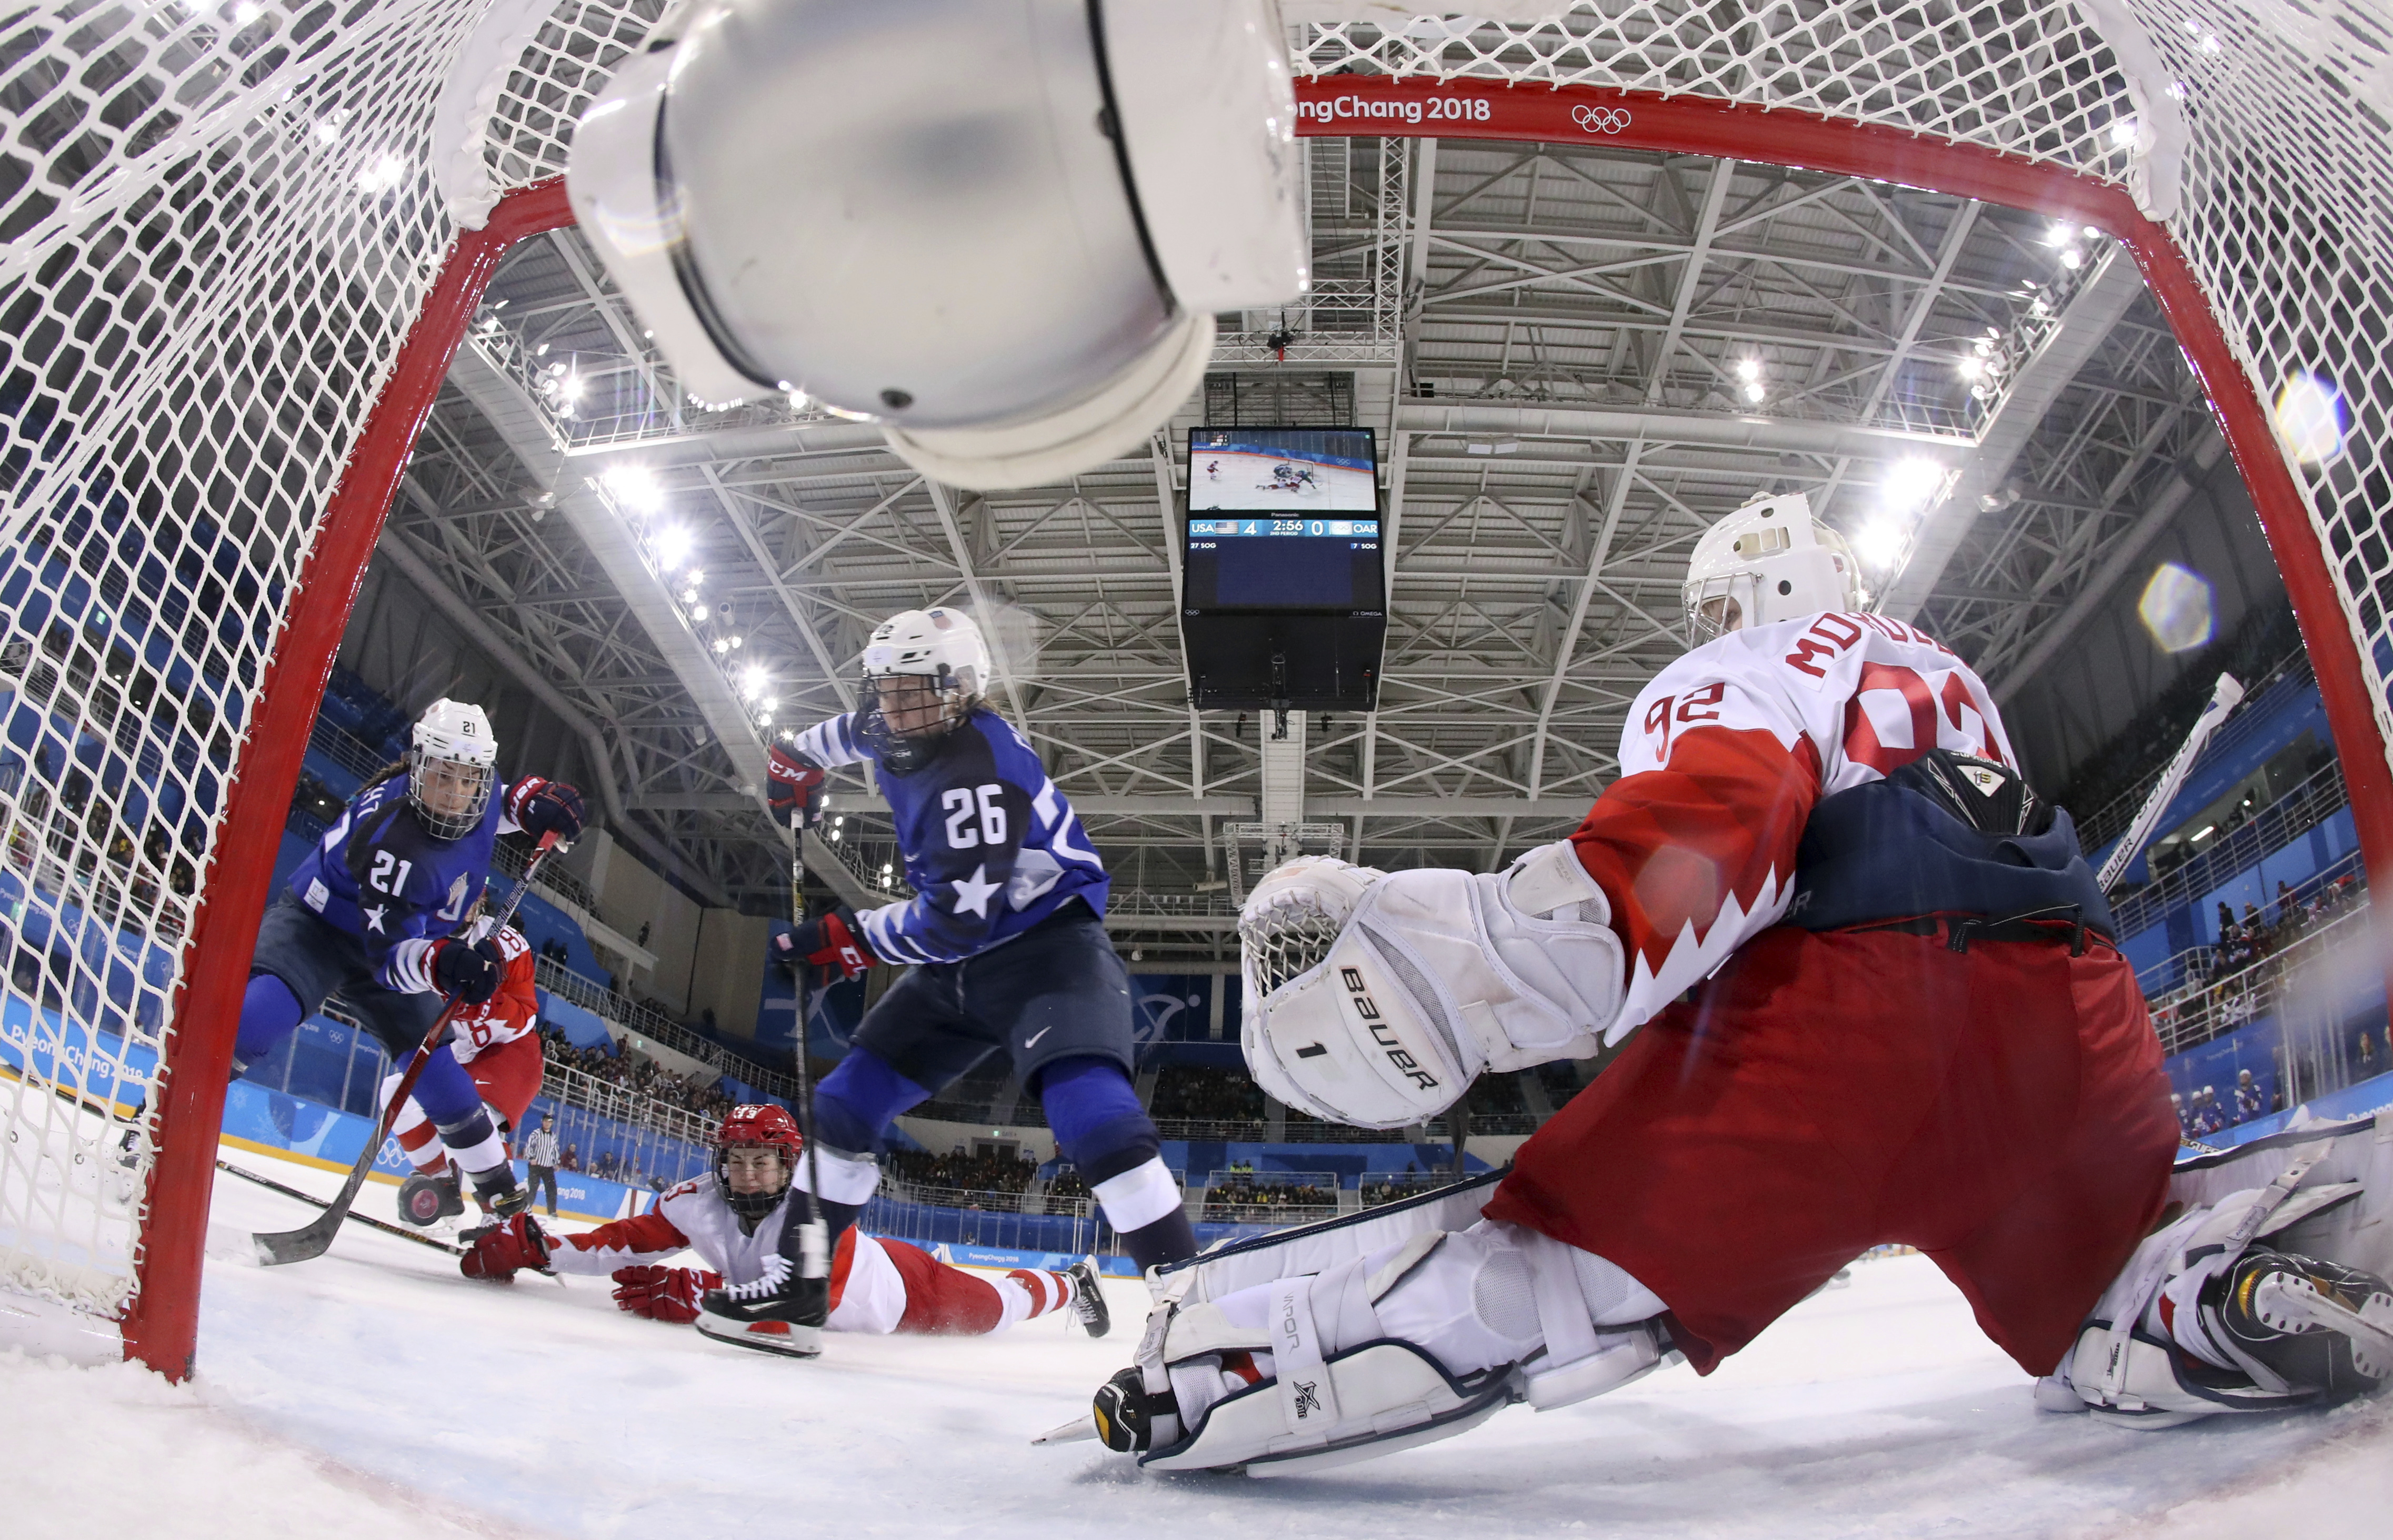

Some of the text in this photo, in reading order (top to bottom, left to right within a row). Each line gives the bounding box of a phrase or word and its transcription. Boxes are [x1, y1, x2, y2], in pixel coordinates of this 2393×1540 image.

[1426, 97, 1491, 121] 2018
[1192, 524, 1214, 532] USA
[1244, 521, 1257, 535] 4
[1273, 520, 1304, 531] 2:56
[1311, 520, 1324, 536] 0
[1353, 524, 1378, 533] OAR
[463, 721, 476, 734] 21
[1644, 682, 1725, 762] 92
[941, 784, 1007, 849] 26
[370, 849, 412, 898] 21
[486, 878, 528, 939] BAUER
[1341, 968, 1438, 1090] BAUER
[1296, 1041, 1328, 1059] 1
[570, 1187, 585, 1200] 2018
[969, 1252, 1005, 1263] PyeongChang
[1283, 1291, 1300, 1355] VAPOR
